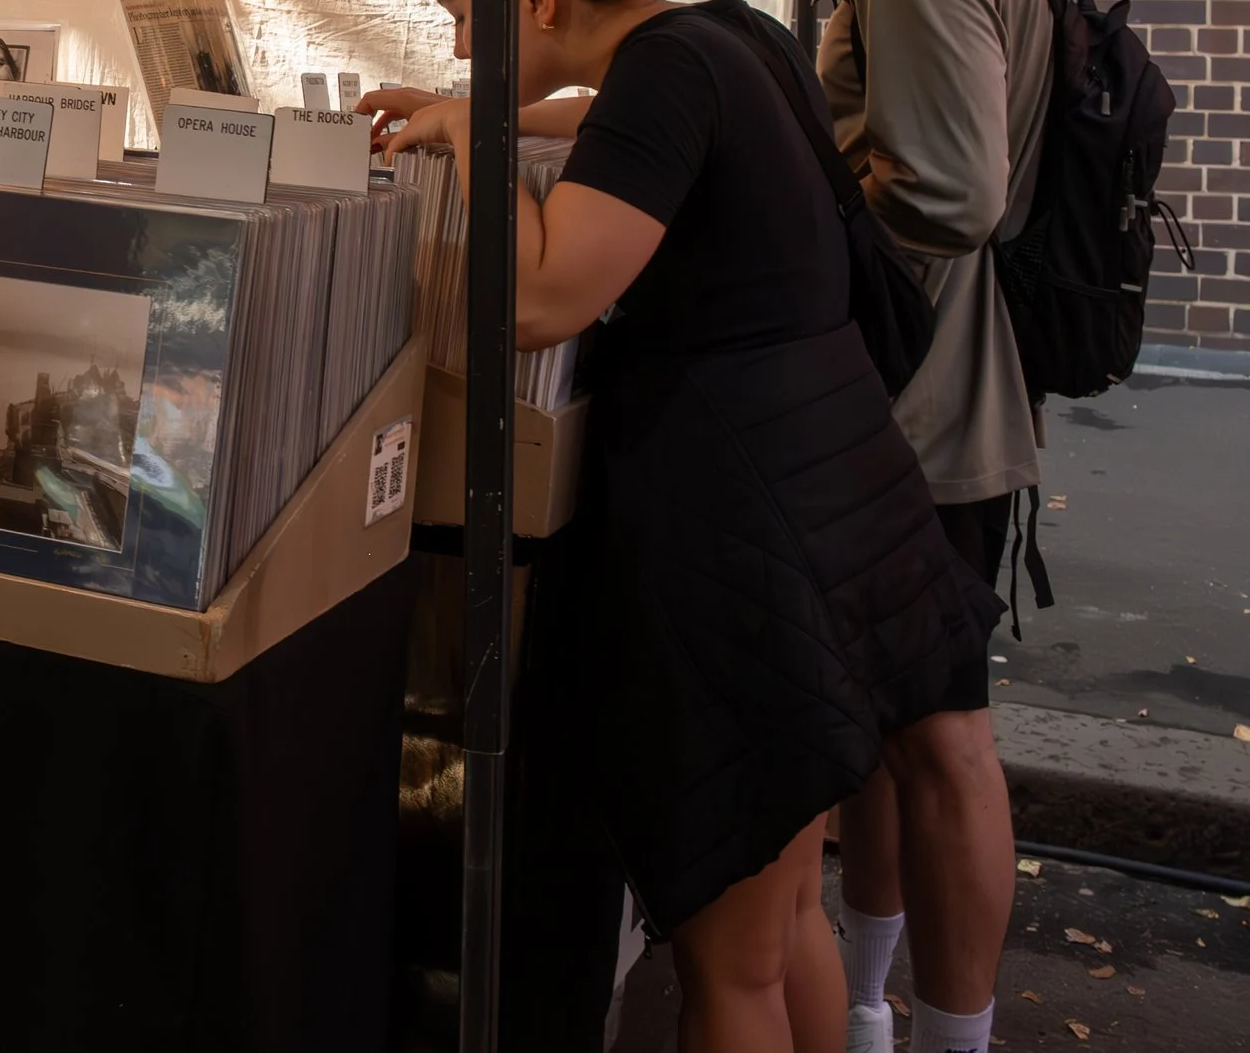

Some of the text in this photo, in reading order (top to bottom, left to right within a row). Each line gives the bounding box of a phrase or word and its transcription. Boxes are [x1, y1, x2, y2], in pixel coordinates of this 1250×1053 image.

[61, 98, 96, 111] BRIDGE
[12, 111, 36, 124] CITY
[292, 109, 354, 126] THE ROCKS
[178, 117, 257, 138] OPERA HOUSE
